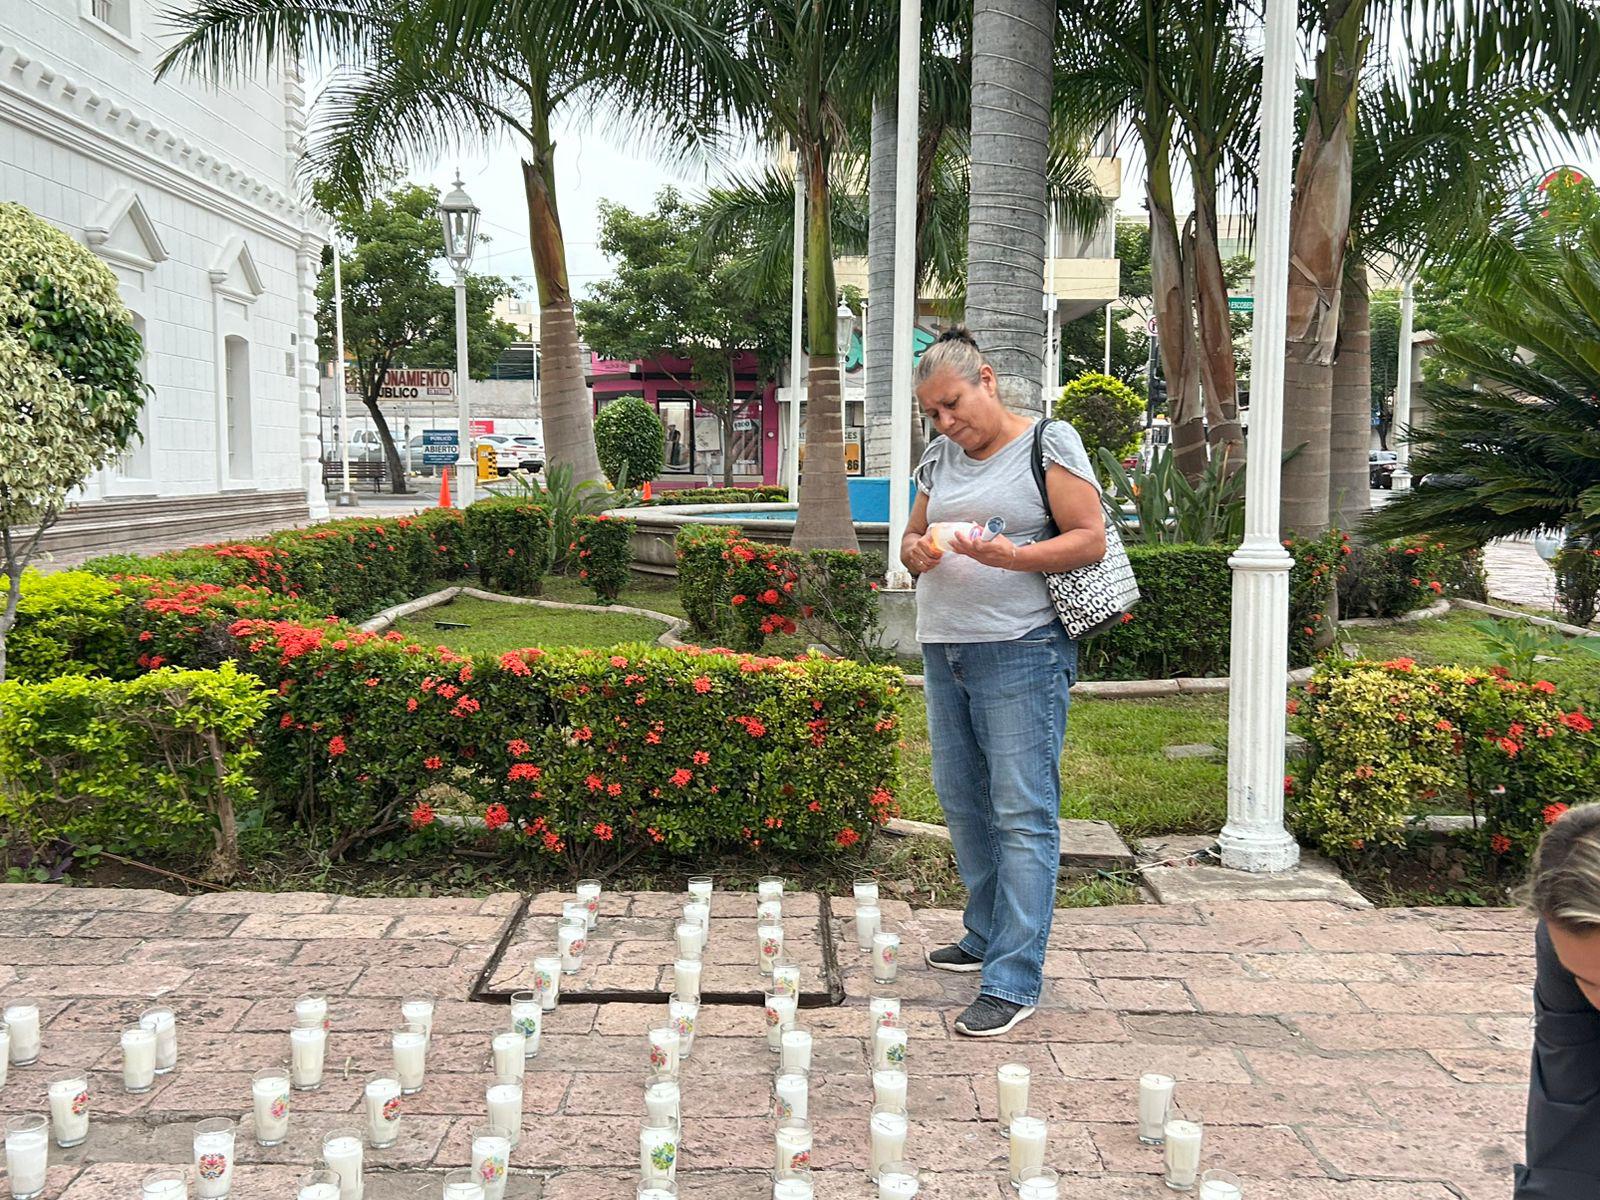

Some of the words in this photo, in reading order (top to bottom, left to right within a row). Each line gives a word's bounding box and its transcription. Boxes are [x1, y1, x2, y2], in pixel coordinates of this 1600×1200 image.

[345, 370, 450, 387] EONAMIENTO
[377, 387, 419, 398] UBLICO
[425, 445, 457, 453] ABIERTO
